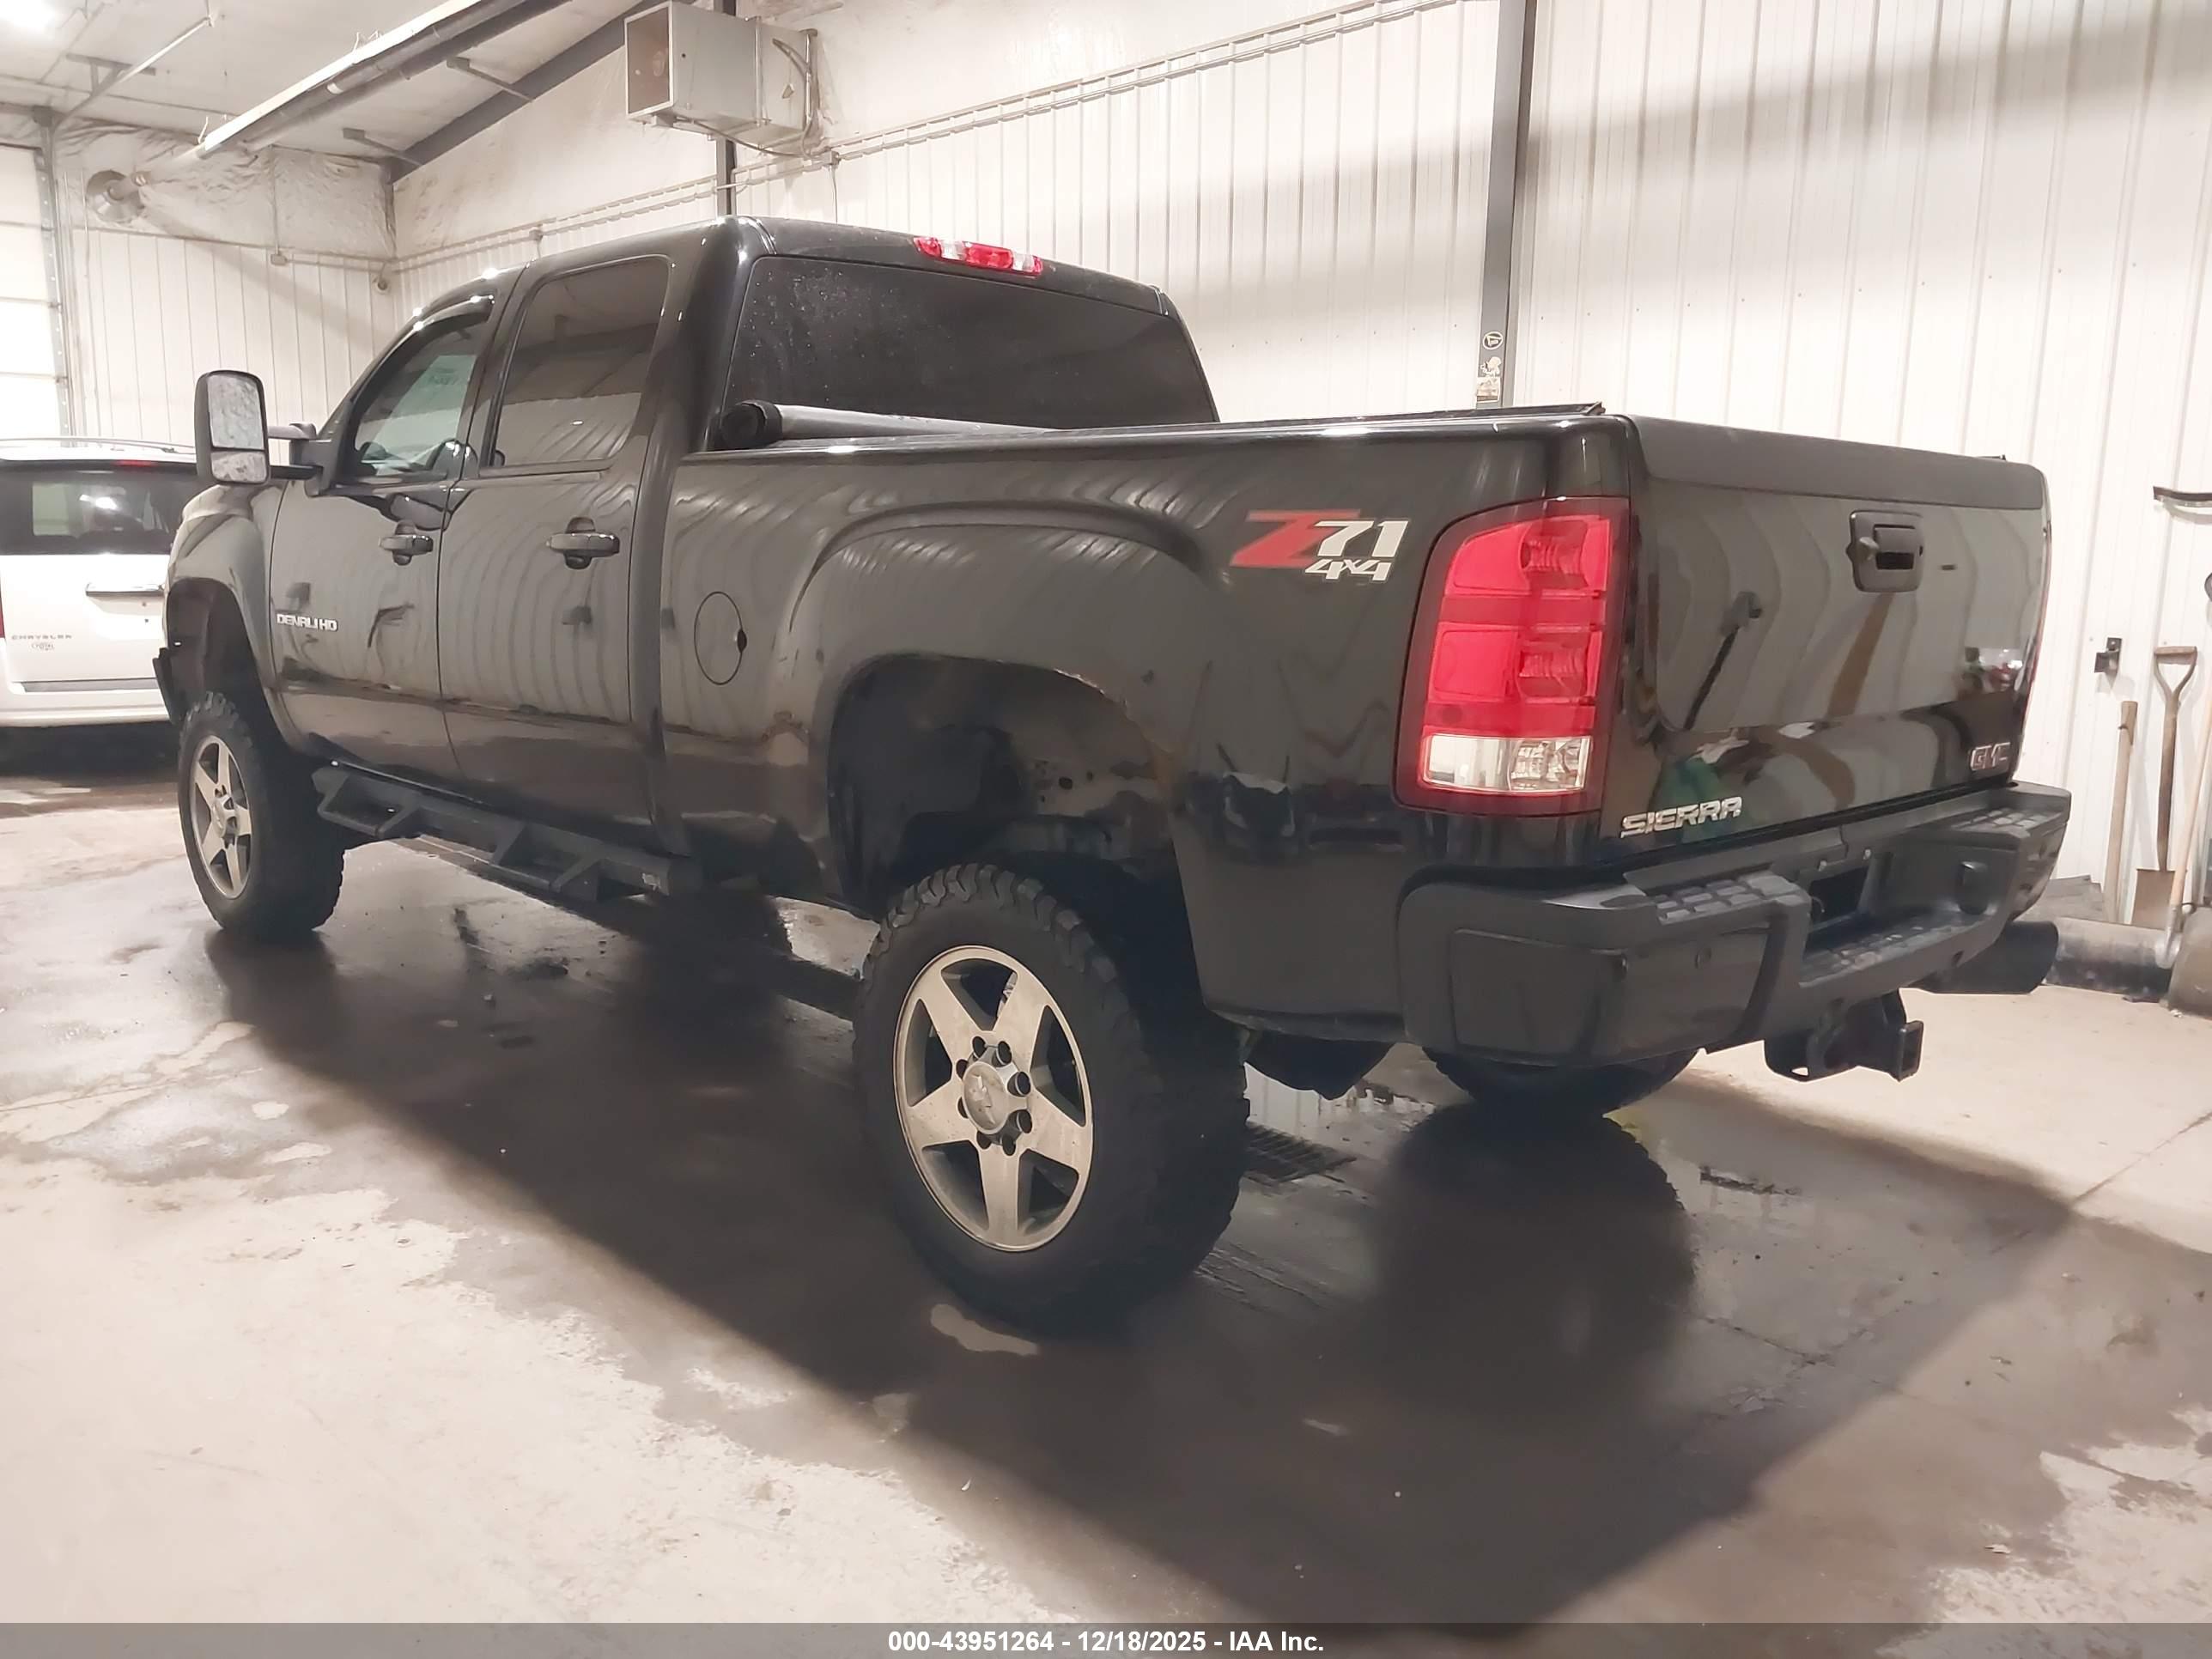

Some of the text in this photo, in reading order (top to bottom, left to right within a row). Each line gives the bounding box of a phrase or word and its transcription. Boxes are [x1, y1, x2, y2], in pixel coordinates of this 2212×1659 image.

[1230, 509, 1409, 568] Z71
[276, 613, 337, 631] DENALI HD
[1970, 742, 2010, 771] GMC
[1620, 796, 1742, 838] SIERRA
